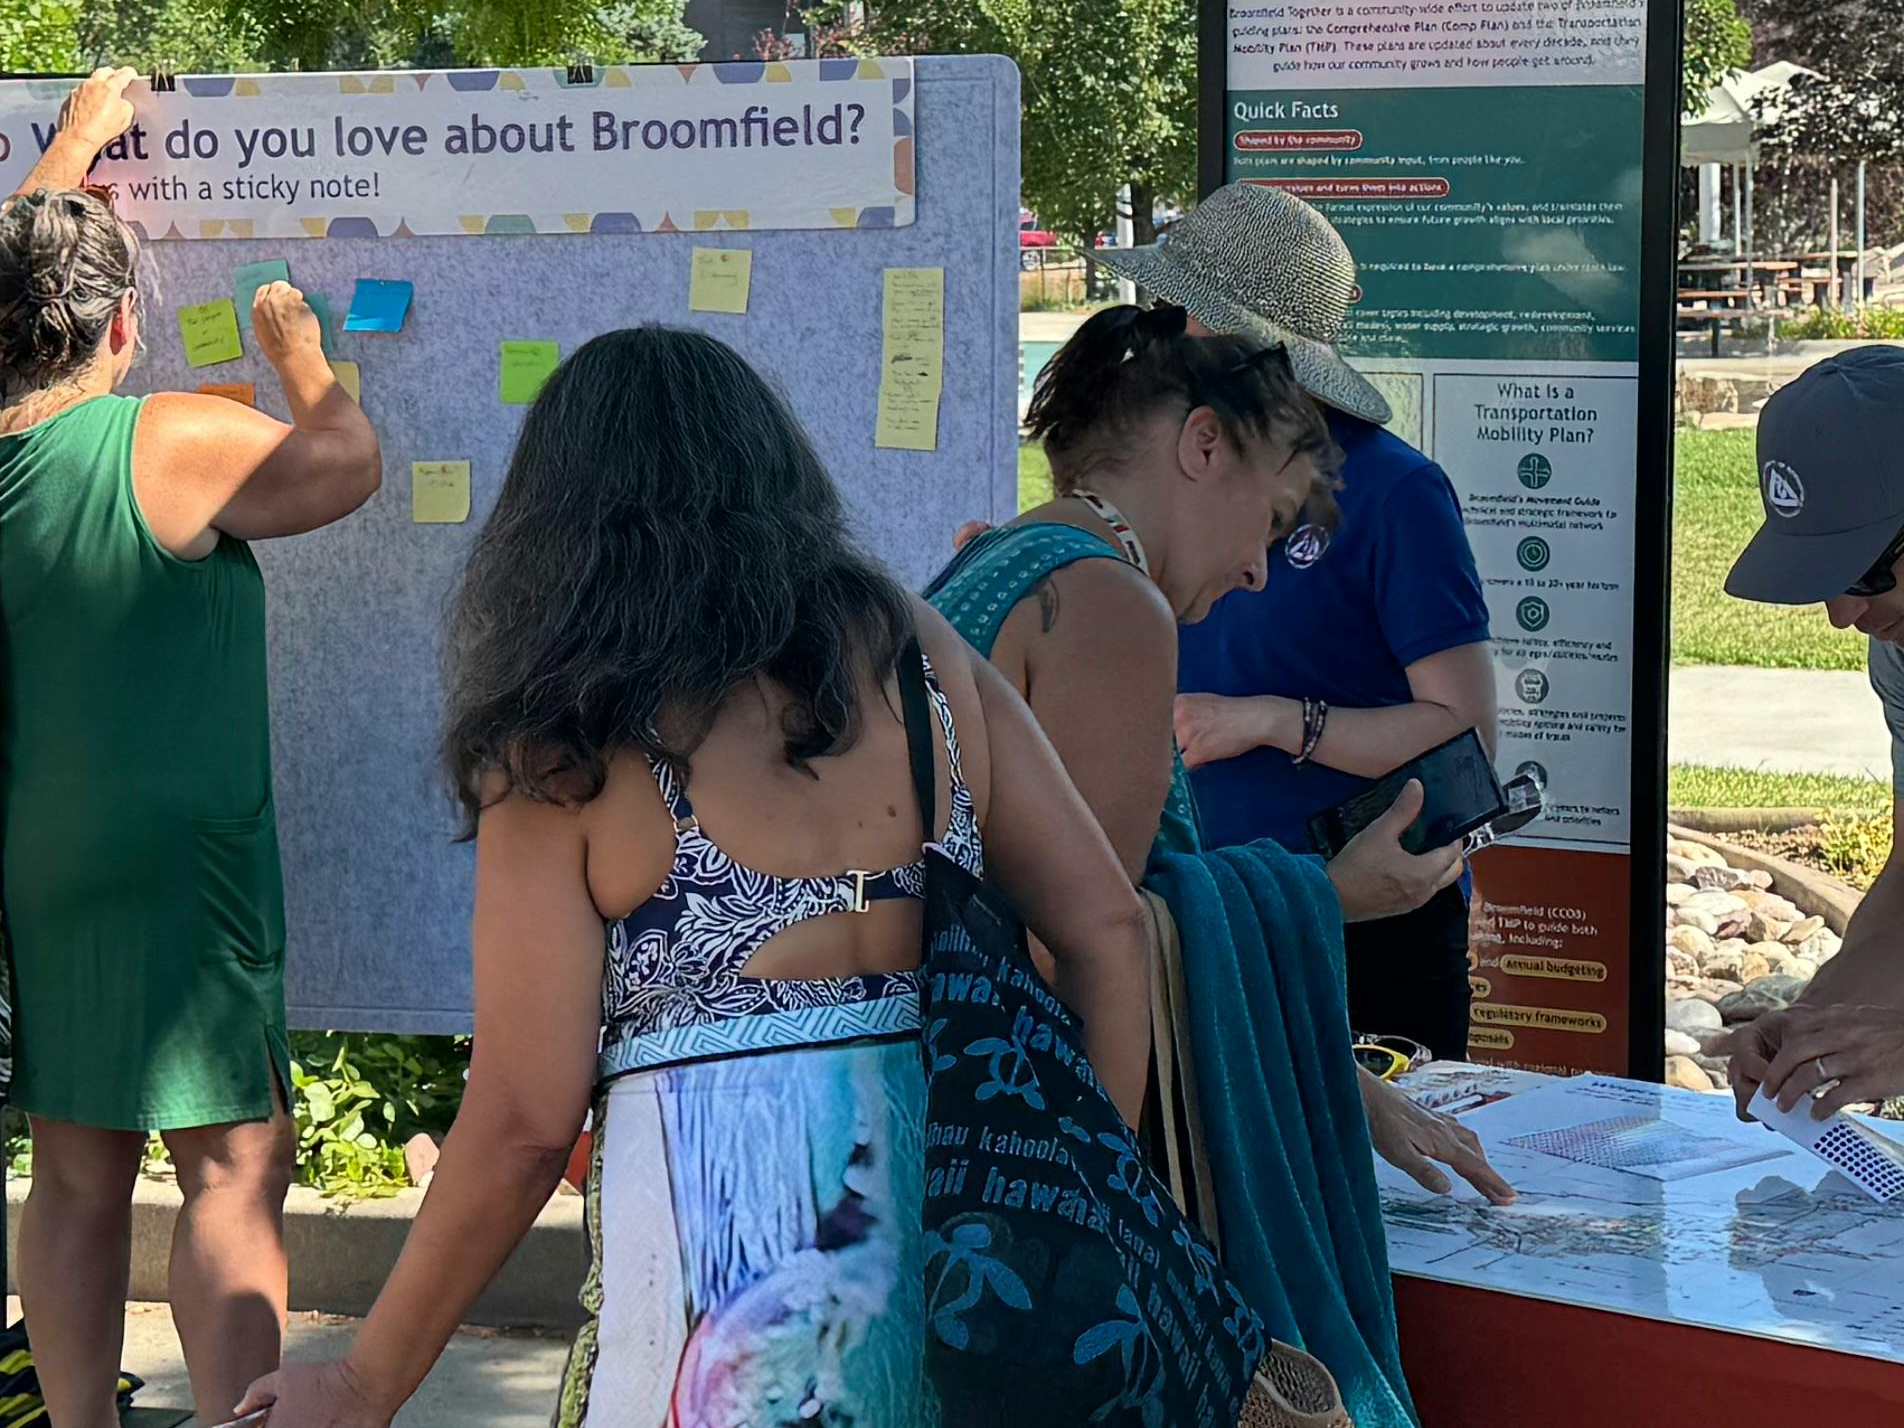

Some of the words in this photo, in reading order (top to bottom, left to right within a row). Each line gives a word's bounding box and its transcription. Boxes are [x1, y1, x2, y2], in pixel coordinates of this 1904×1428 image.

[1234, 102, 1285, 120] Quick
[1291, 101, 1338, 119] Facts
[165, 120, 219, 159] do
[239, 126, 316, 171] you
[335, 115, 428, 157] love
[445, 114, 575, 154] about
[593, 103, 865, 152] Broomfield?
[129, 173, 189, 201] with
[199, 179, 212, 200] a
[224, 174, 299, 205] sticky
[309, 172, 381, 200] note!
[1497, 383, 1540, 398] What
[1564, 384, 1573, 398] a
[1474, 404, 1597, 423] Transportation
[1477, 426, 1543, 443] Mobility
[1550, 428, 1593, 445] Plan?
[1535, 1011, 1601, 1029] frameworks
